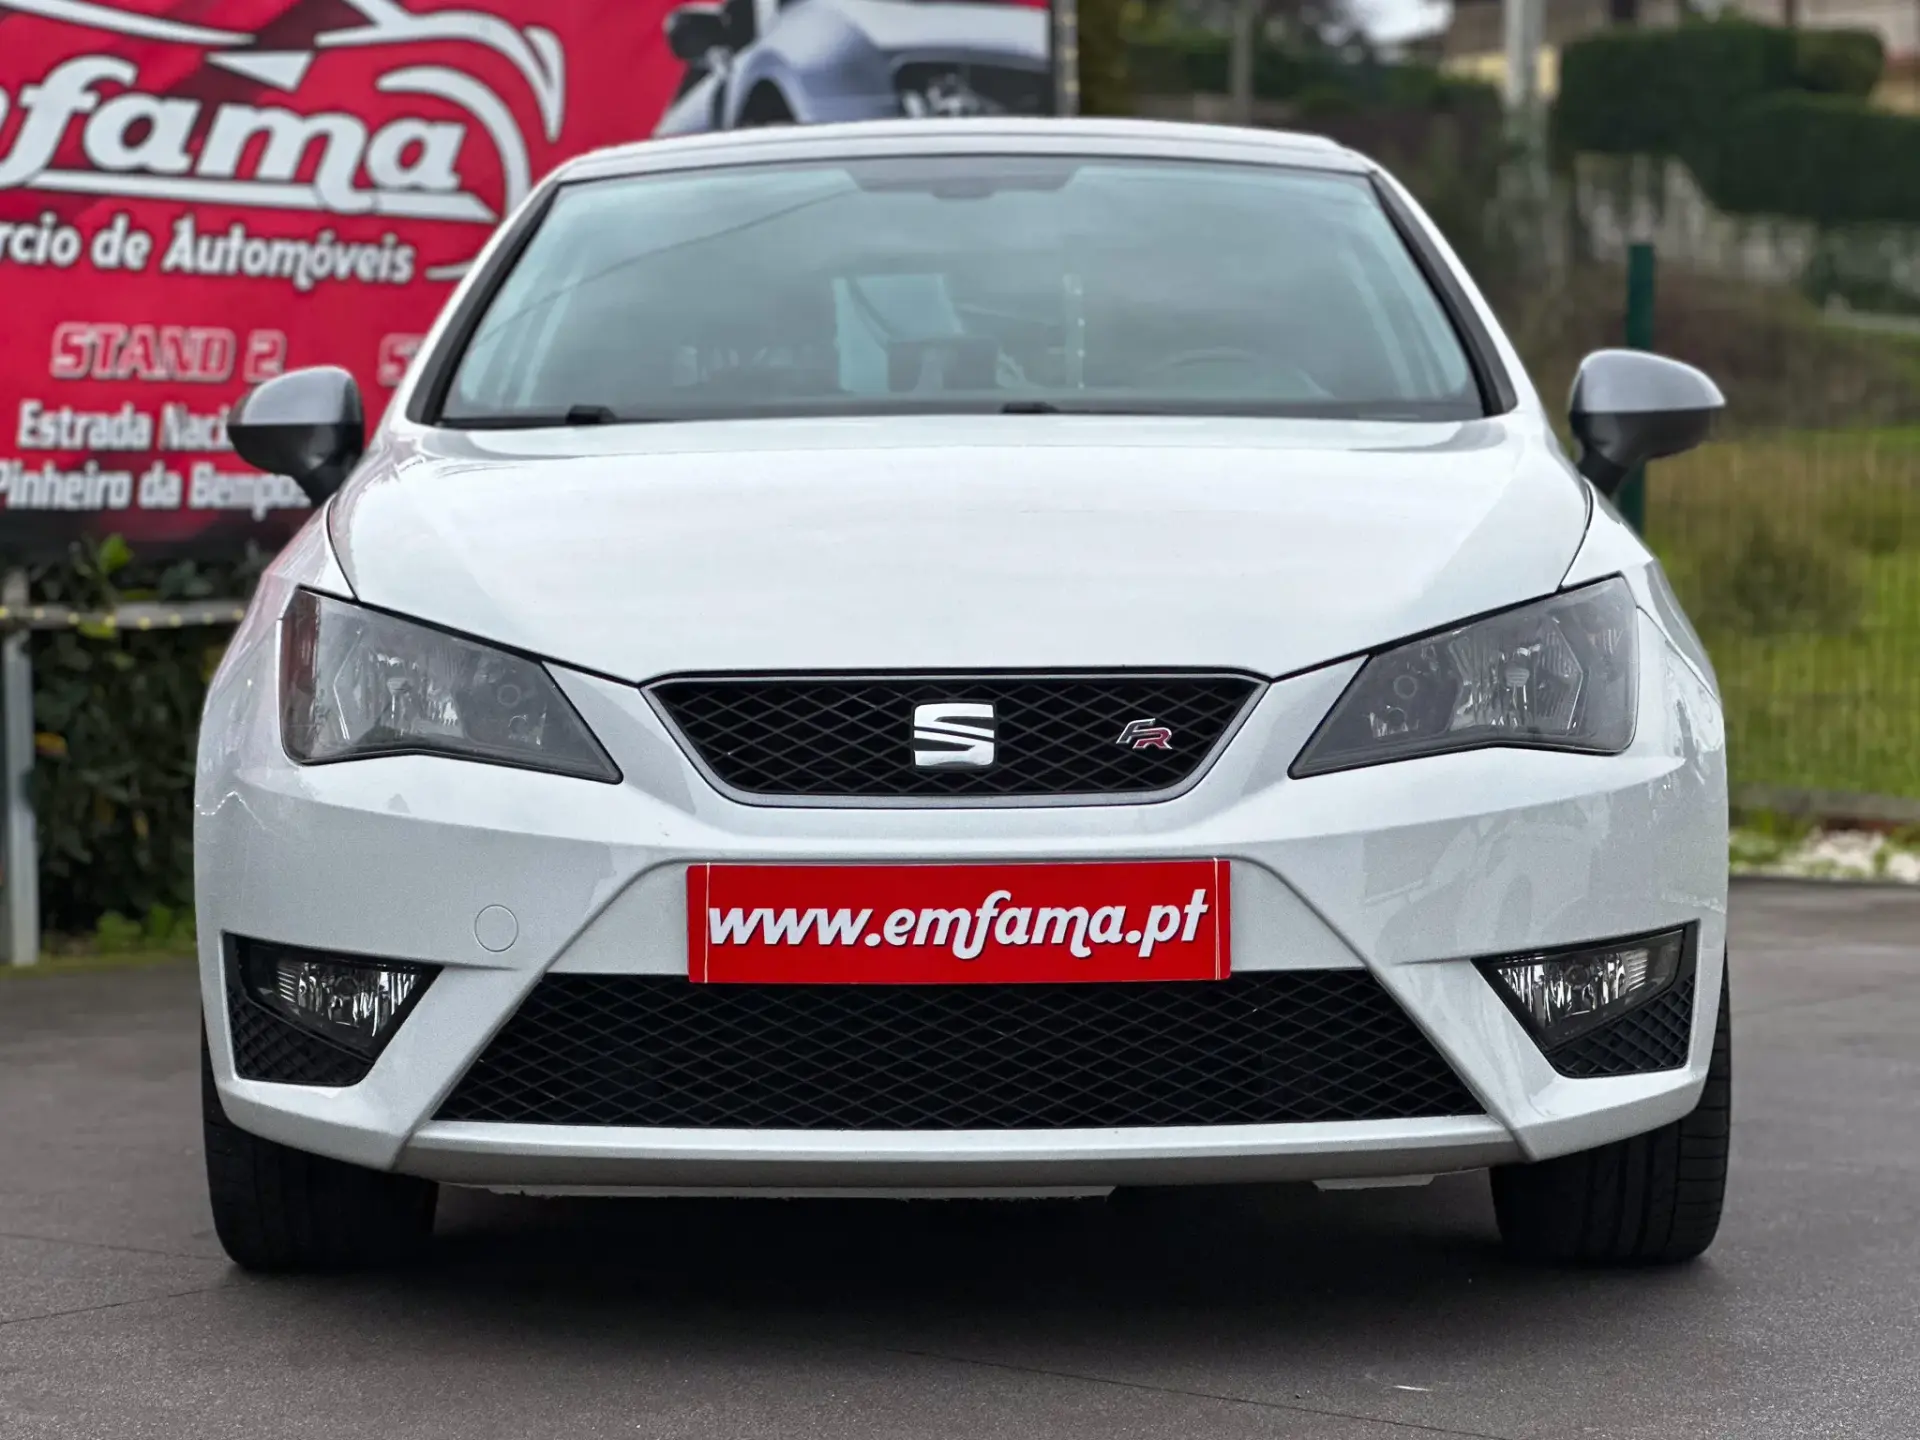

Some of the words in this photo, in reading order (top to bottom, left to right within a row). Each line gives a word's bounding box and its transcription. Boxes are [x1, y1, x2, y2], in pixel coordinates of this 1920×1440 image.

[0, 54, 466, 214] fama
[91, 213, 151, 271] de
[162, 216, 415, 290] Automóveis
[50, 322, 234, 383] STAND
[244, 331, 286, 383] 2
[17, 399, 152, 450] Estrada
[139, 460, 183, 509] da
[1116, 718, 1173, 750] FR
[708, 889, 1209, 960] www.emfama.pt
